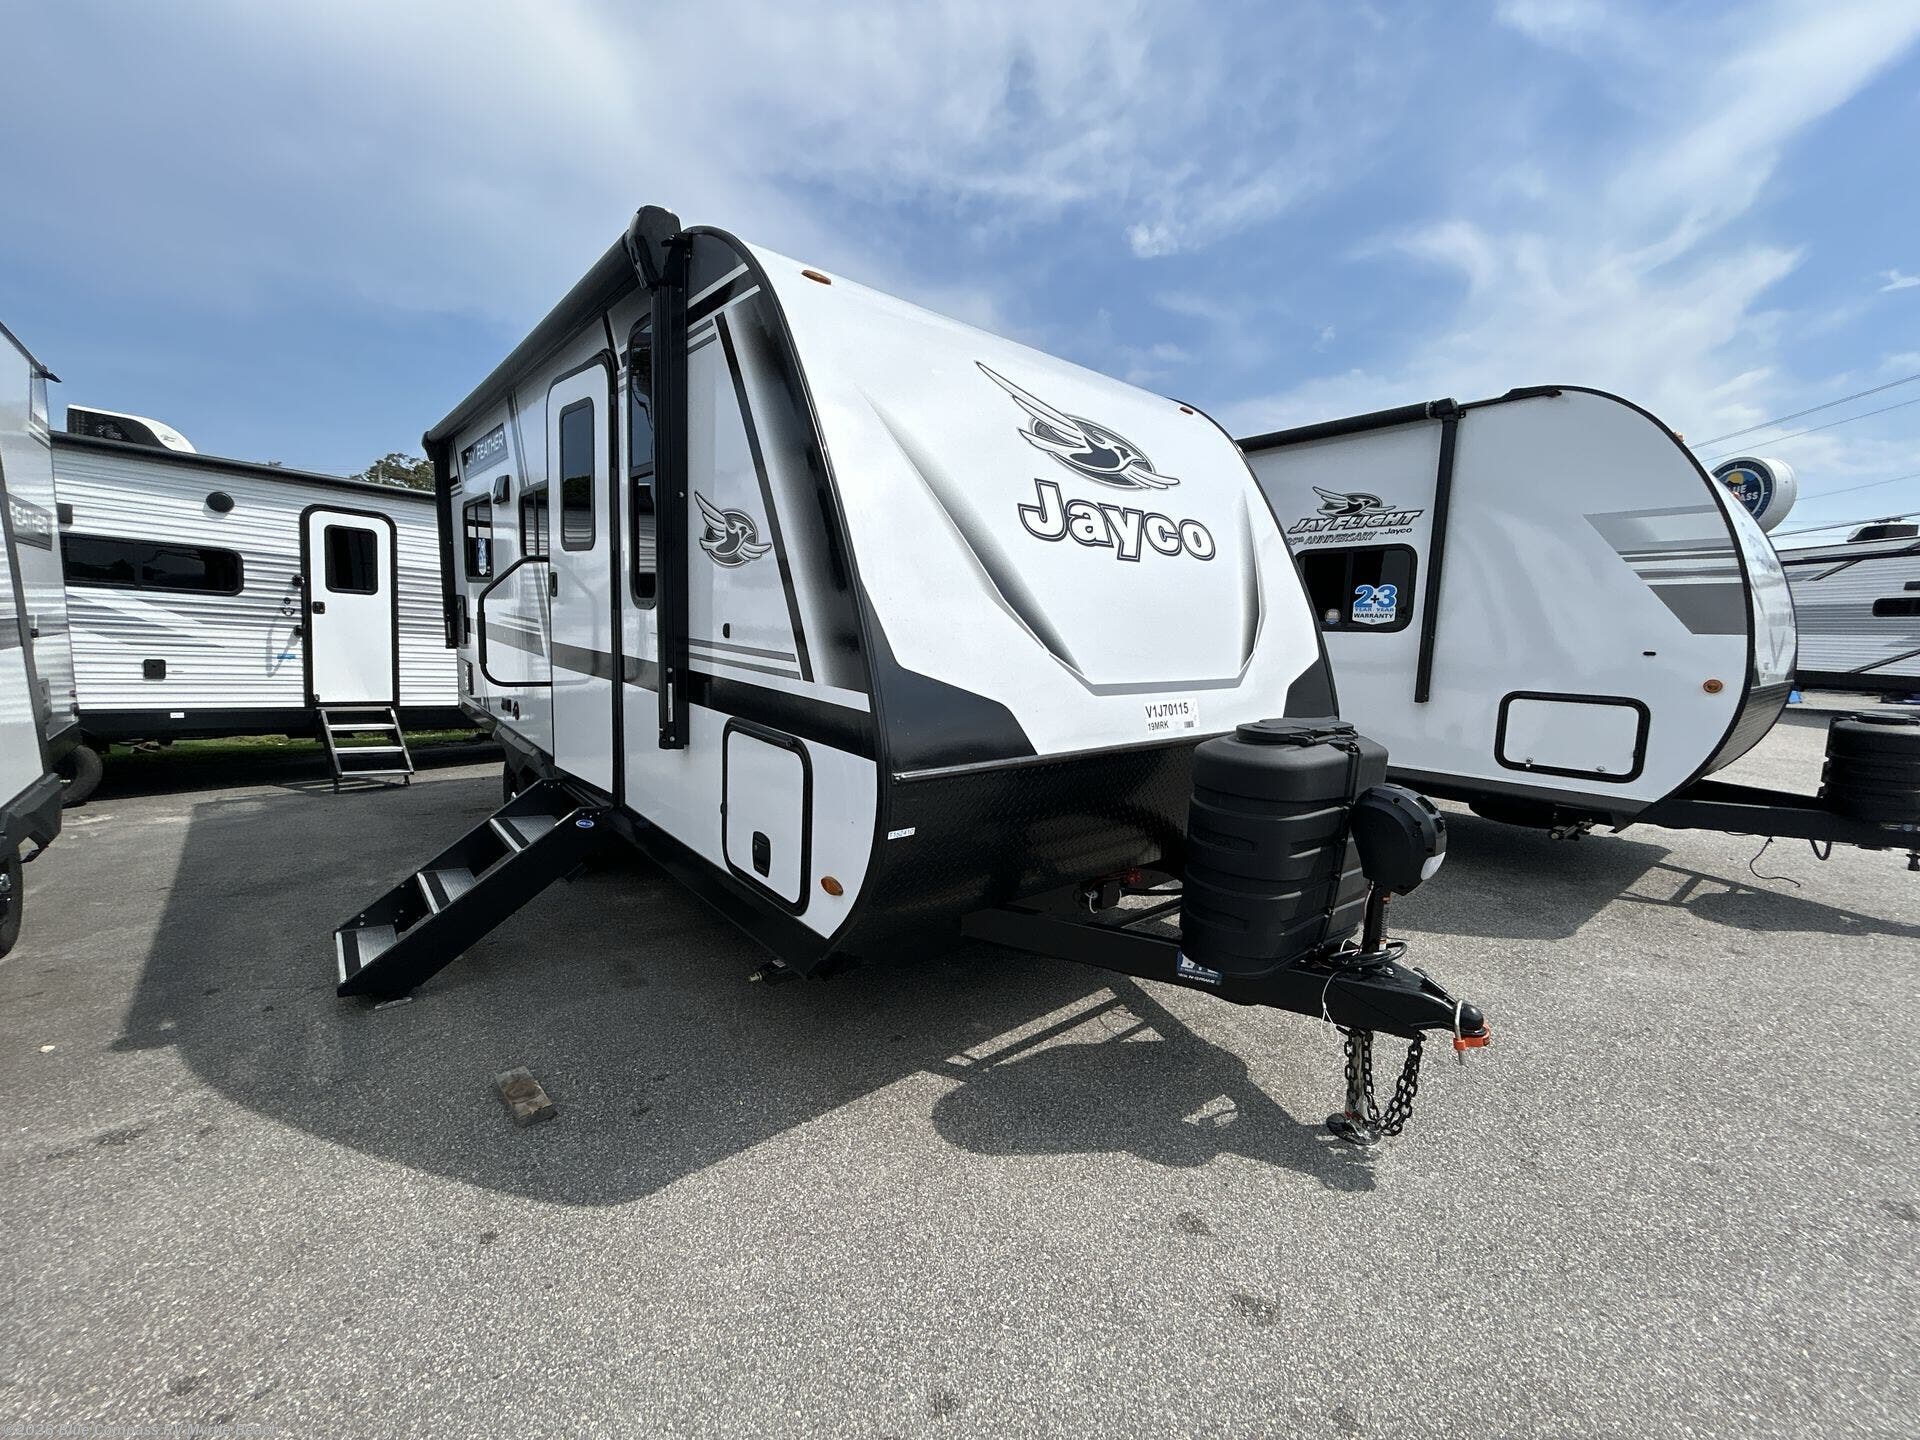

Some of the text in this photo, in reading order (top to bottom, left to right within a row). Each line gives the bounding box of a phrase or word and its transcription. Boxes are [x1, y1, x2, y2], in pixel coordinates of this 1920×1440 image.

[1018, 478, 1216, 562] Jayco
[1328, 510, 1424, 531] FLIGHT
[1304, 531, 1378, 545] ANNIVERSARY
[1384, 527, 1413, 535] Jayco
[1145, 702, 1189, 718] V1J70115
[1148, 720, 1169, 731] 19MRK
